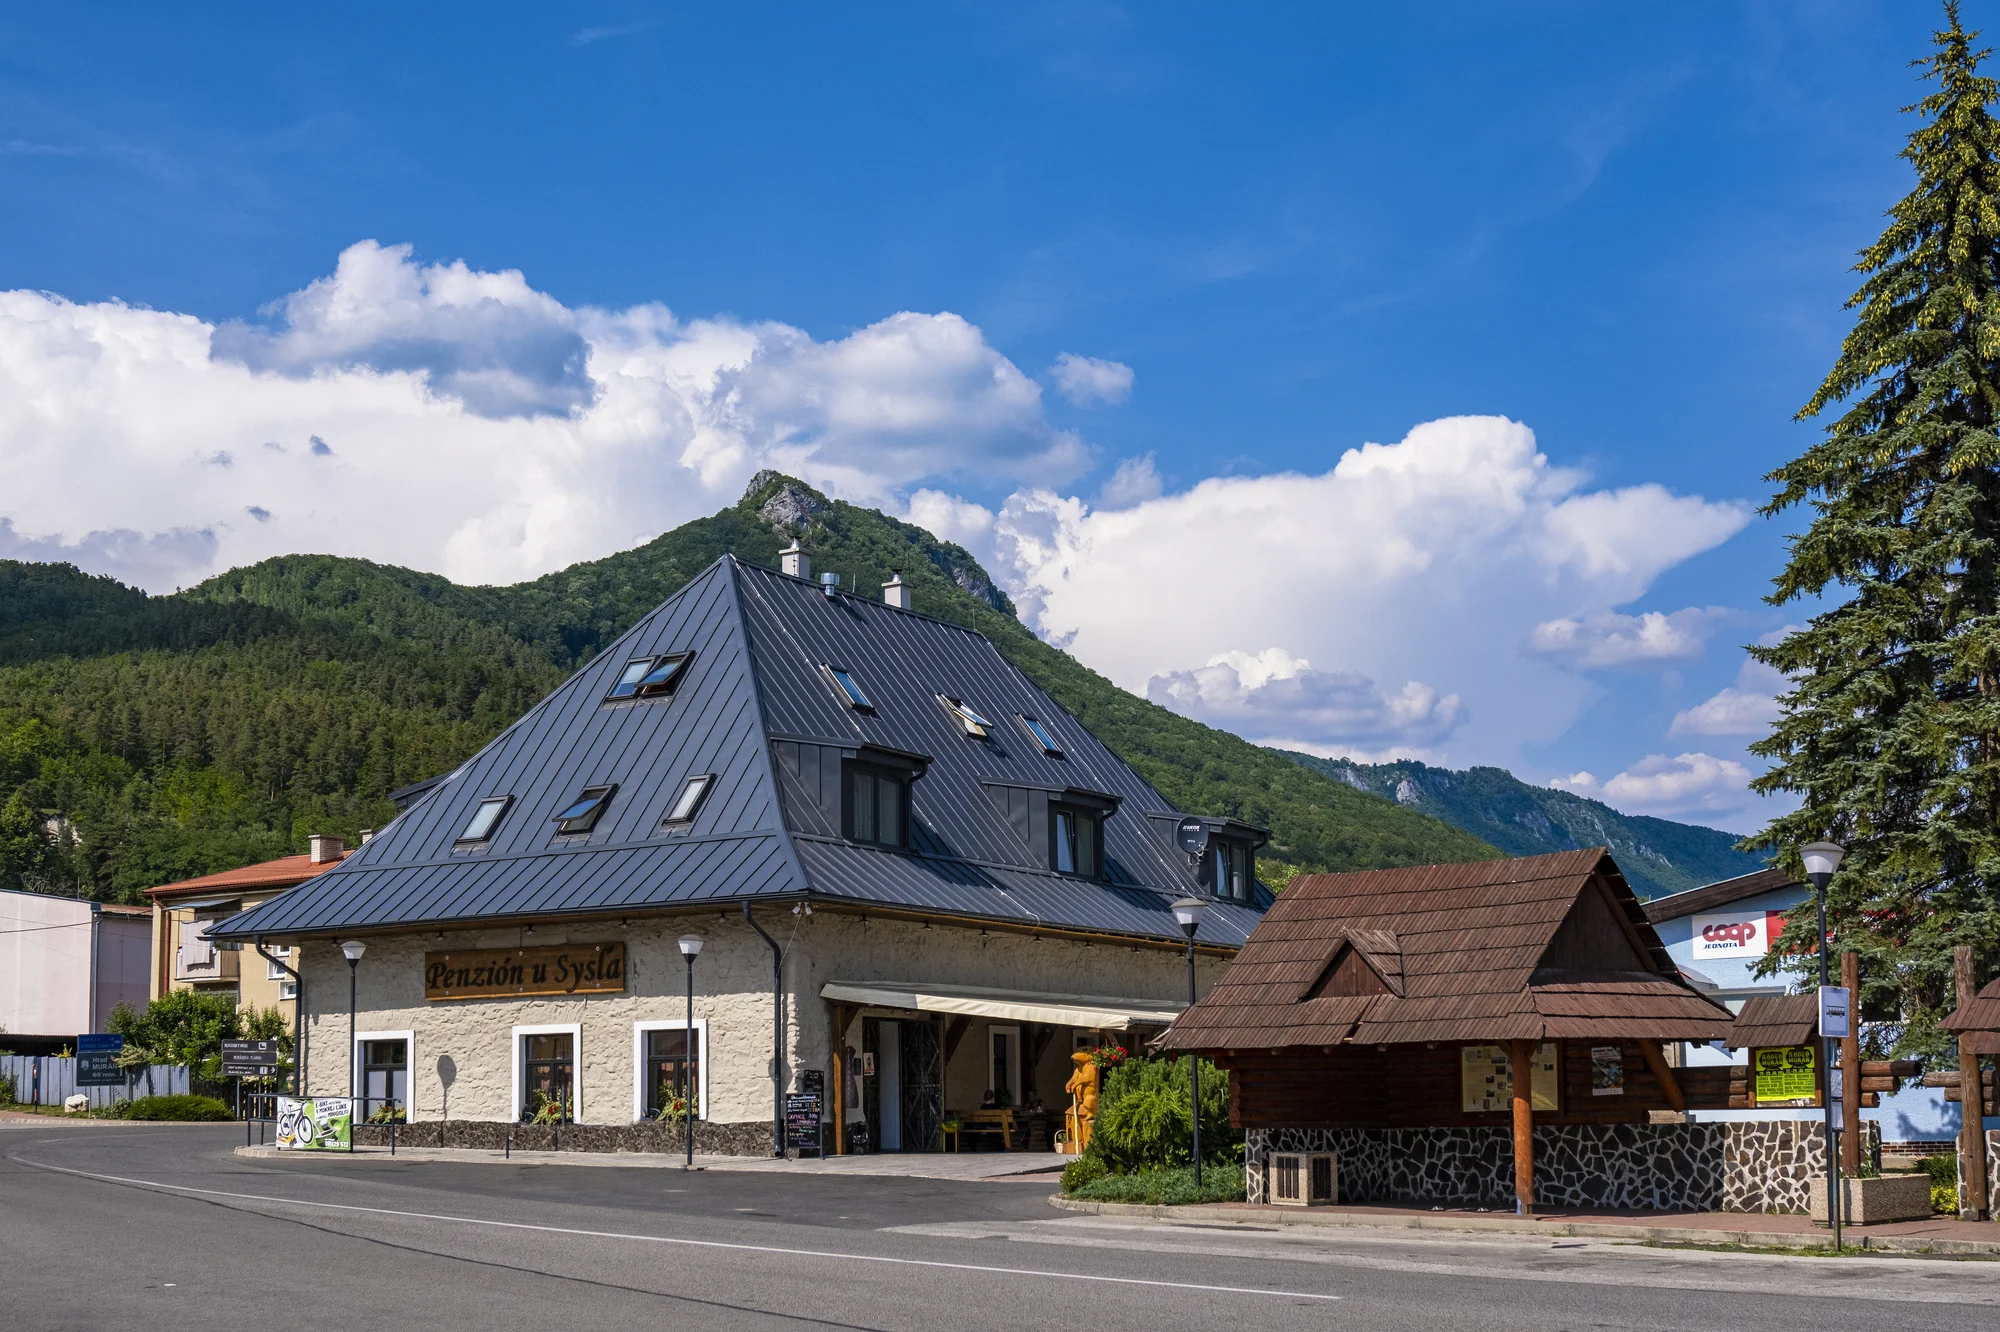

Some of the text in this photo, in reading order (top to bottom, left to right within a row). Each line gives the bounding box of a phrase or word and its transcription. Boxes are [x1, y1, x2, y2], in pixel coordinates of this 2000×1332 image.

[1702, 922, 1756, 947] coop
[1703, 942, 1738, 950] JEDNOTA
[425, 957, 524, 990] Penzión
[531, 962, 547, 984] u
